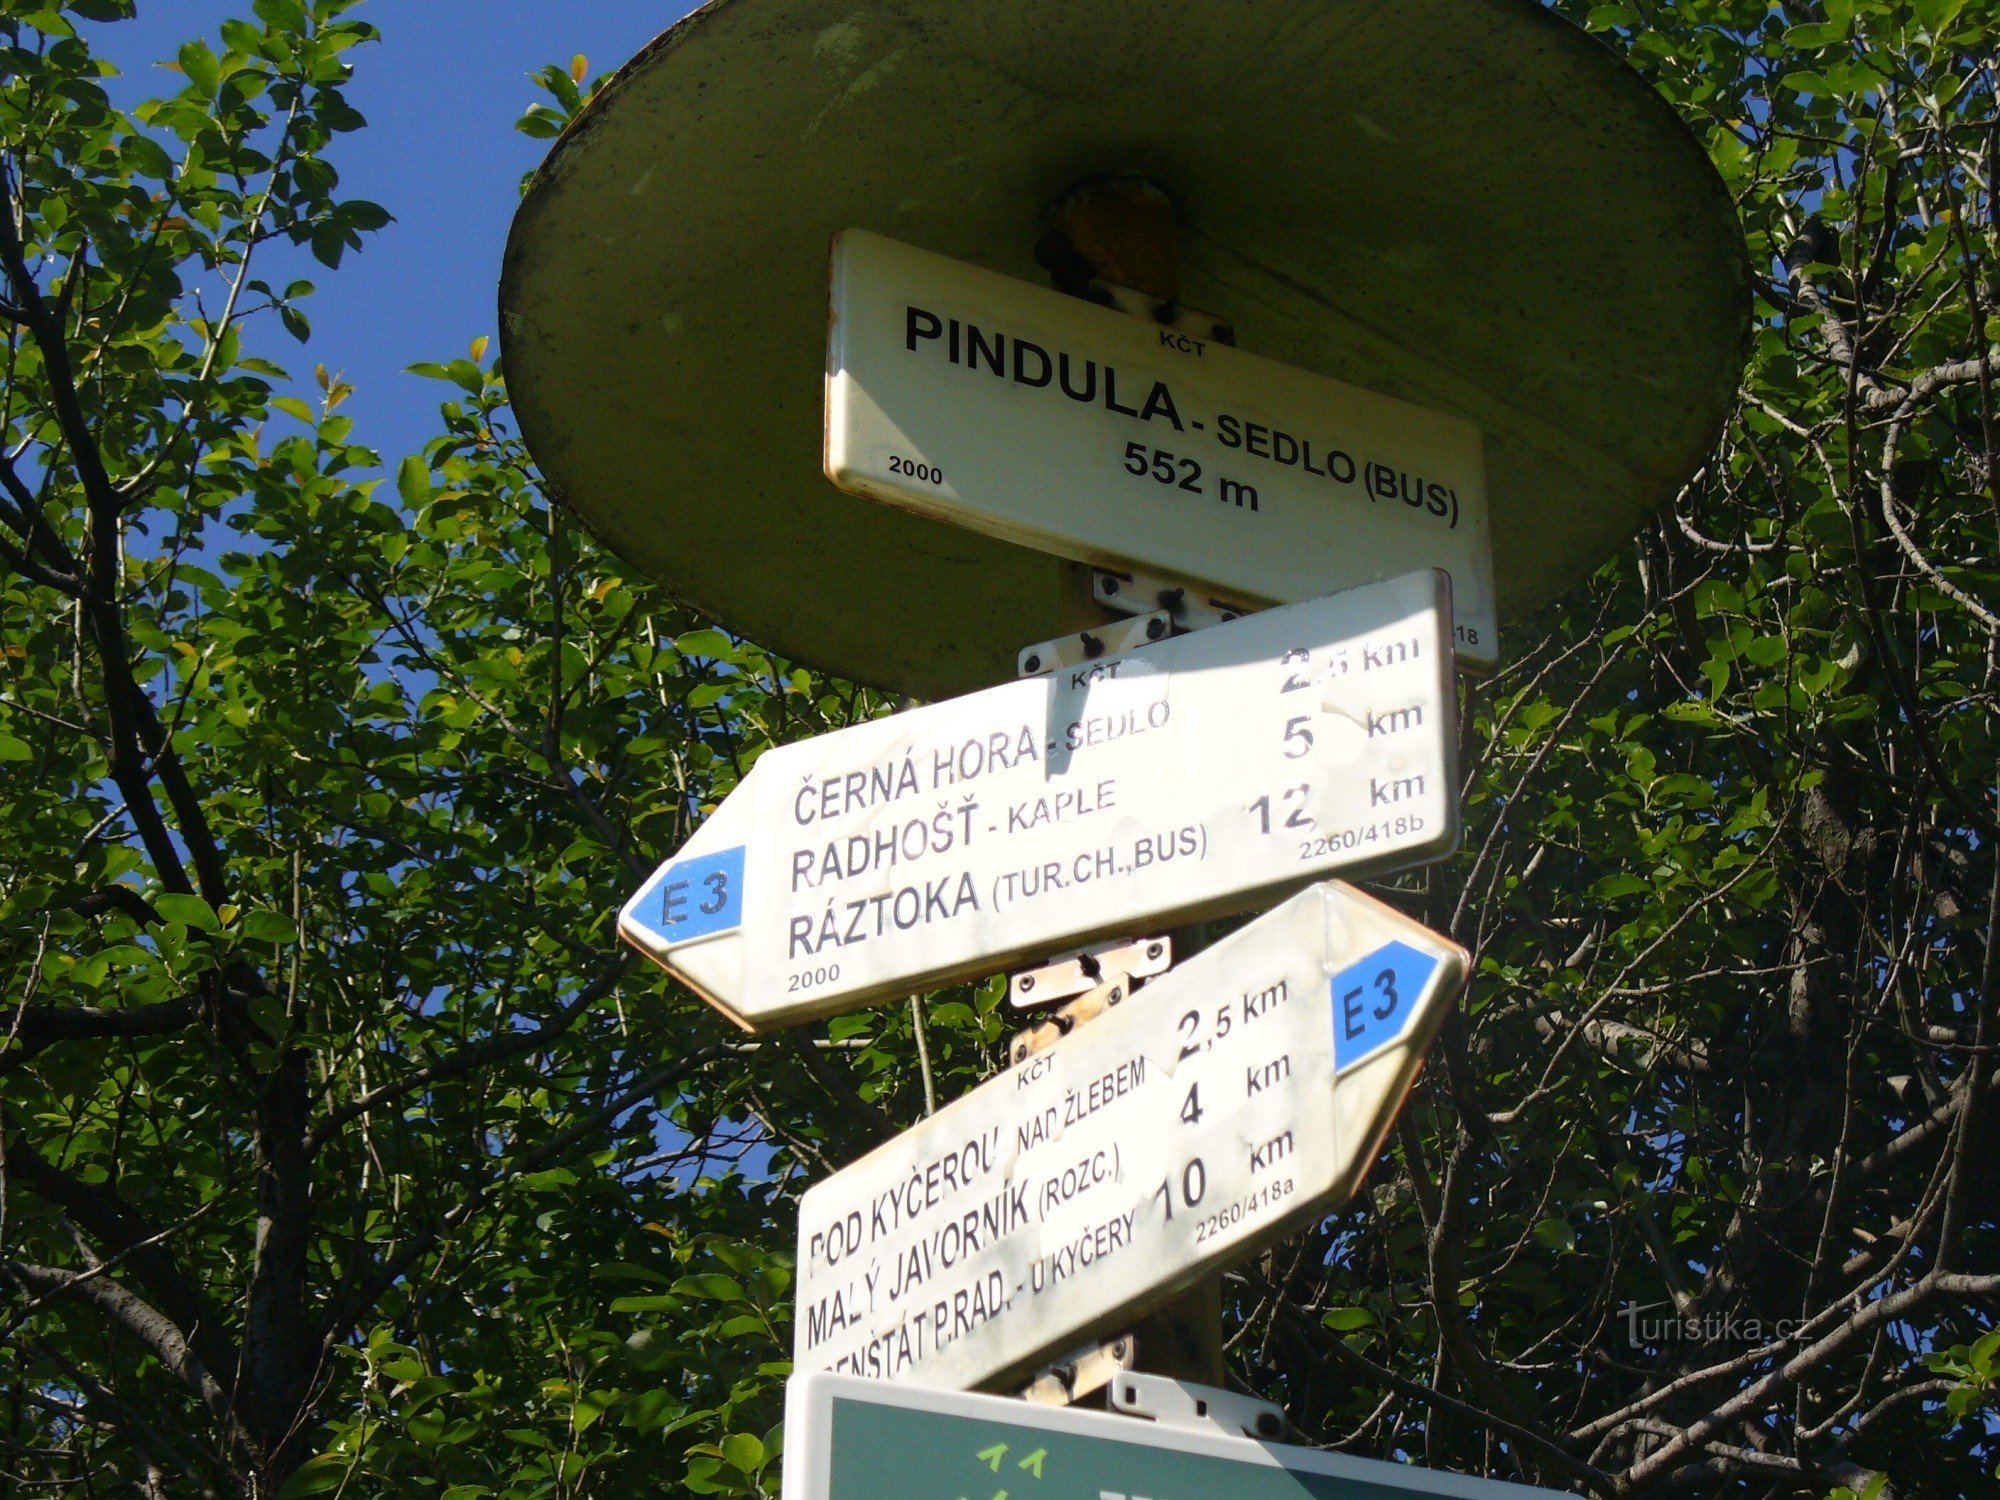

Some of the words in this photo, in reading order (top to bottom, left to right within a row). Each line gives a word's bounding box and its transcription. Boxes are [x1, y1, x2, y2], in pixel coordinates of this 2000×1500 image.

[1159, 329, 1206, 357] KČT
[905, 305, 1185, 432] PINDULA
[1217, 414, 1357, 485] SEDLO
[1364, 460, 1459, 529] (BUS)
[888, 455, 943, 485] 2000
[1124, 441, 1203, 494] 552
[1220, 477, 1260, 512] m
[1071, 660, 1121, 690] KČT
[794, 743, 921, 826] ČERNÁ
[933, 724, 1039, 789] HORA
[1066, 699, 1170, 752] SEDLO
[1363, 638, 1419, 671] km
[792, 794, 980, 893] RADHOŠŤ
[1009, 779, 1116, 834] KAPLE
[1283, 715, 1313, 759] 5
[1367, 704, 1422, 738] km
[788, 871, 981, 960] RÁZTOKA
[1249, 783, 1314, 834] 12
[1370, 774, 1424, 807] km
[1300, 814, 1424, 860] 2260/418b
[662, 880, 689, 926] E
[700, 870, 728, 914] 3
[788, 964, 841, 993] 2000
[1343, 985, 1366, 1041] E
[1372, 968, 1398, 1021] 3
[1017, 1053, 1056, 1090] KČT
[809, 1210, 862, 1278] POD
[871, 1126, 999, 1242] KYČEROU
[1064, 1055, 1145, 1129] ŽLEBEM
[1177, 1004, 1231, 1063] 2,5
[1243, 979, 1288, 1024] km
[808, 1257, 881, 1350] MALÝ
[889, 1178, 1029, 1301] JAVORNÍK
[1039, 1143, 1120, 1223] (ROZC.)
[1180, 1082, 1203, 1124] 4
[1247, 1054, 1291, 1098] km
[1031, 1260, 1045, 1295] U
[1052, 1208, 1136, 1284] KYČERY
[1154, 1157, 1206, 1222] 10
[1250, 1130, 1294, 1174] km
[1196, 1178, 1294, 1244] 2260/418a
